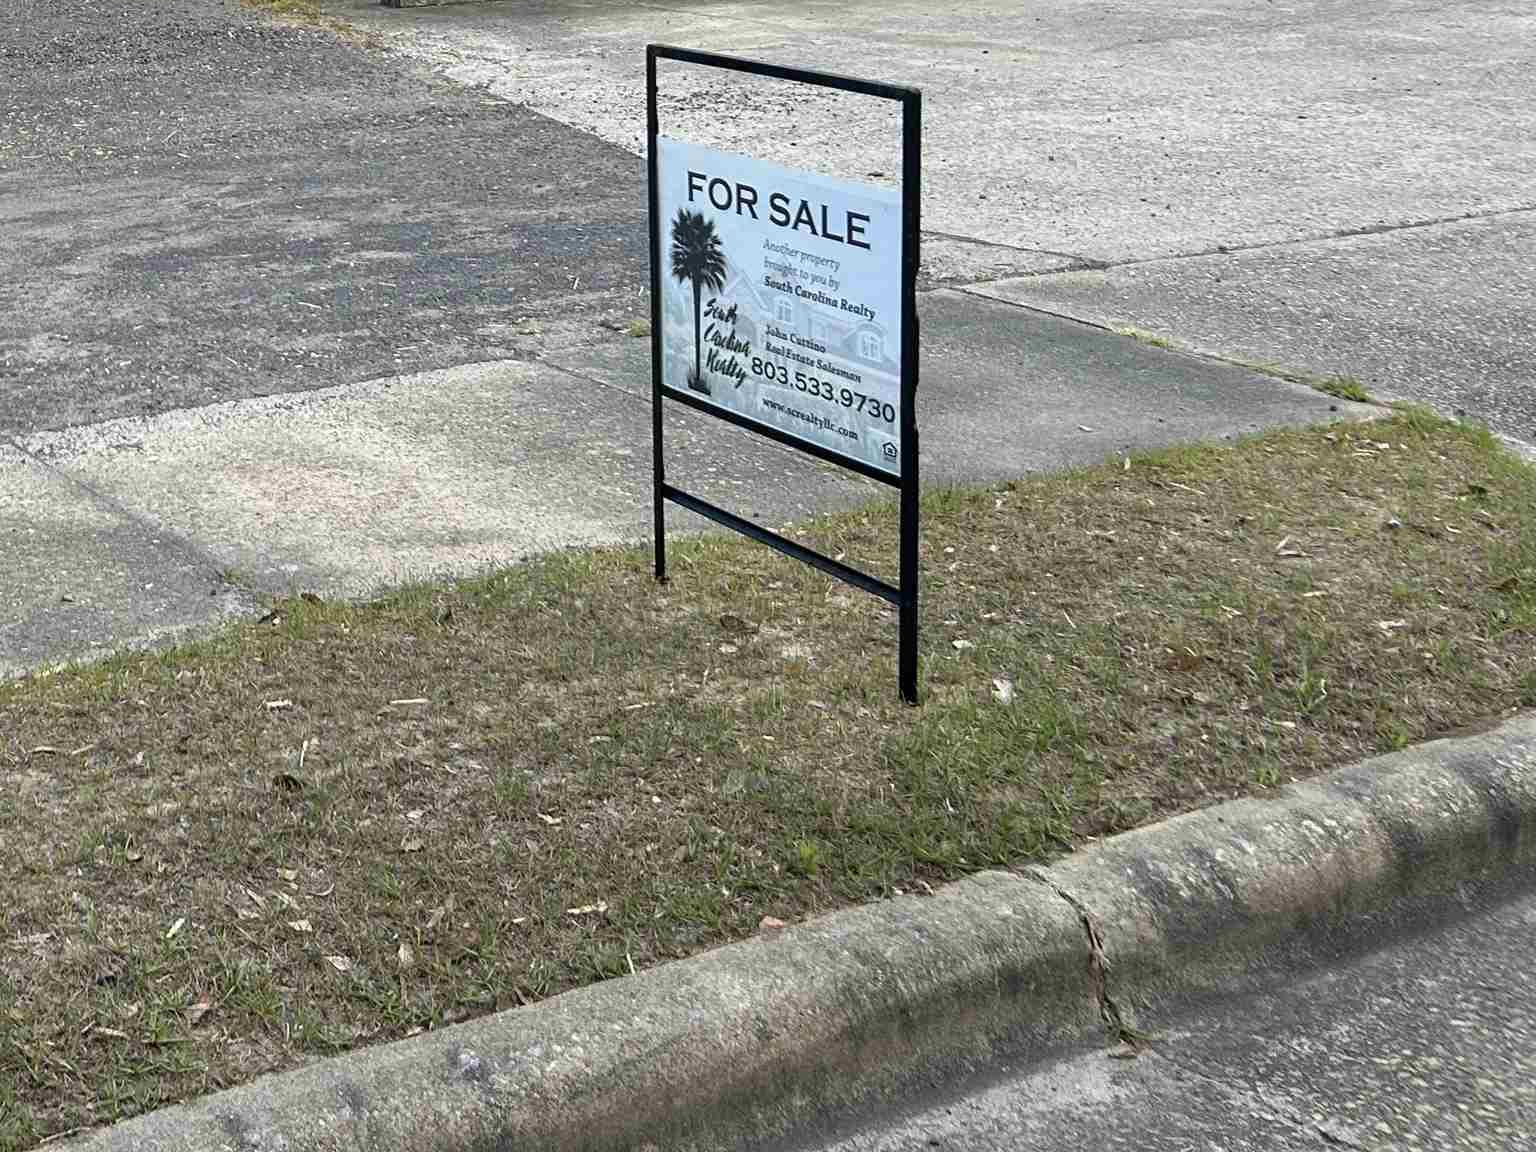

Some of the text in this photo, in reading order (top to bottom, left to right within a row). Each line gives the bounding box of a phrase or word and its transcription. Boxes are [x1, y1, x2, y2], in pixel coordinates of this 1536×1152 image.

[687, 171, 871, 250] FOR SALE
[763, 238, 841, 272] Another property
[764, 275, 876, 321] South Carolina Realty
[799, 269, 809, 280] to
[809, 274, 827, 286] you
[828, 275, 840, 291] by
[785, 348, 815, 367] Estate
[751, 356, 896, 423] 803.533.9730
